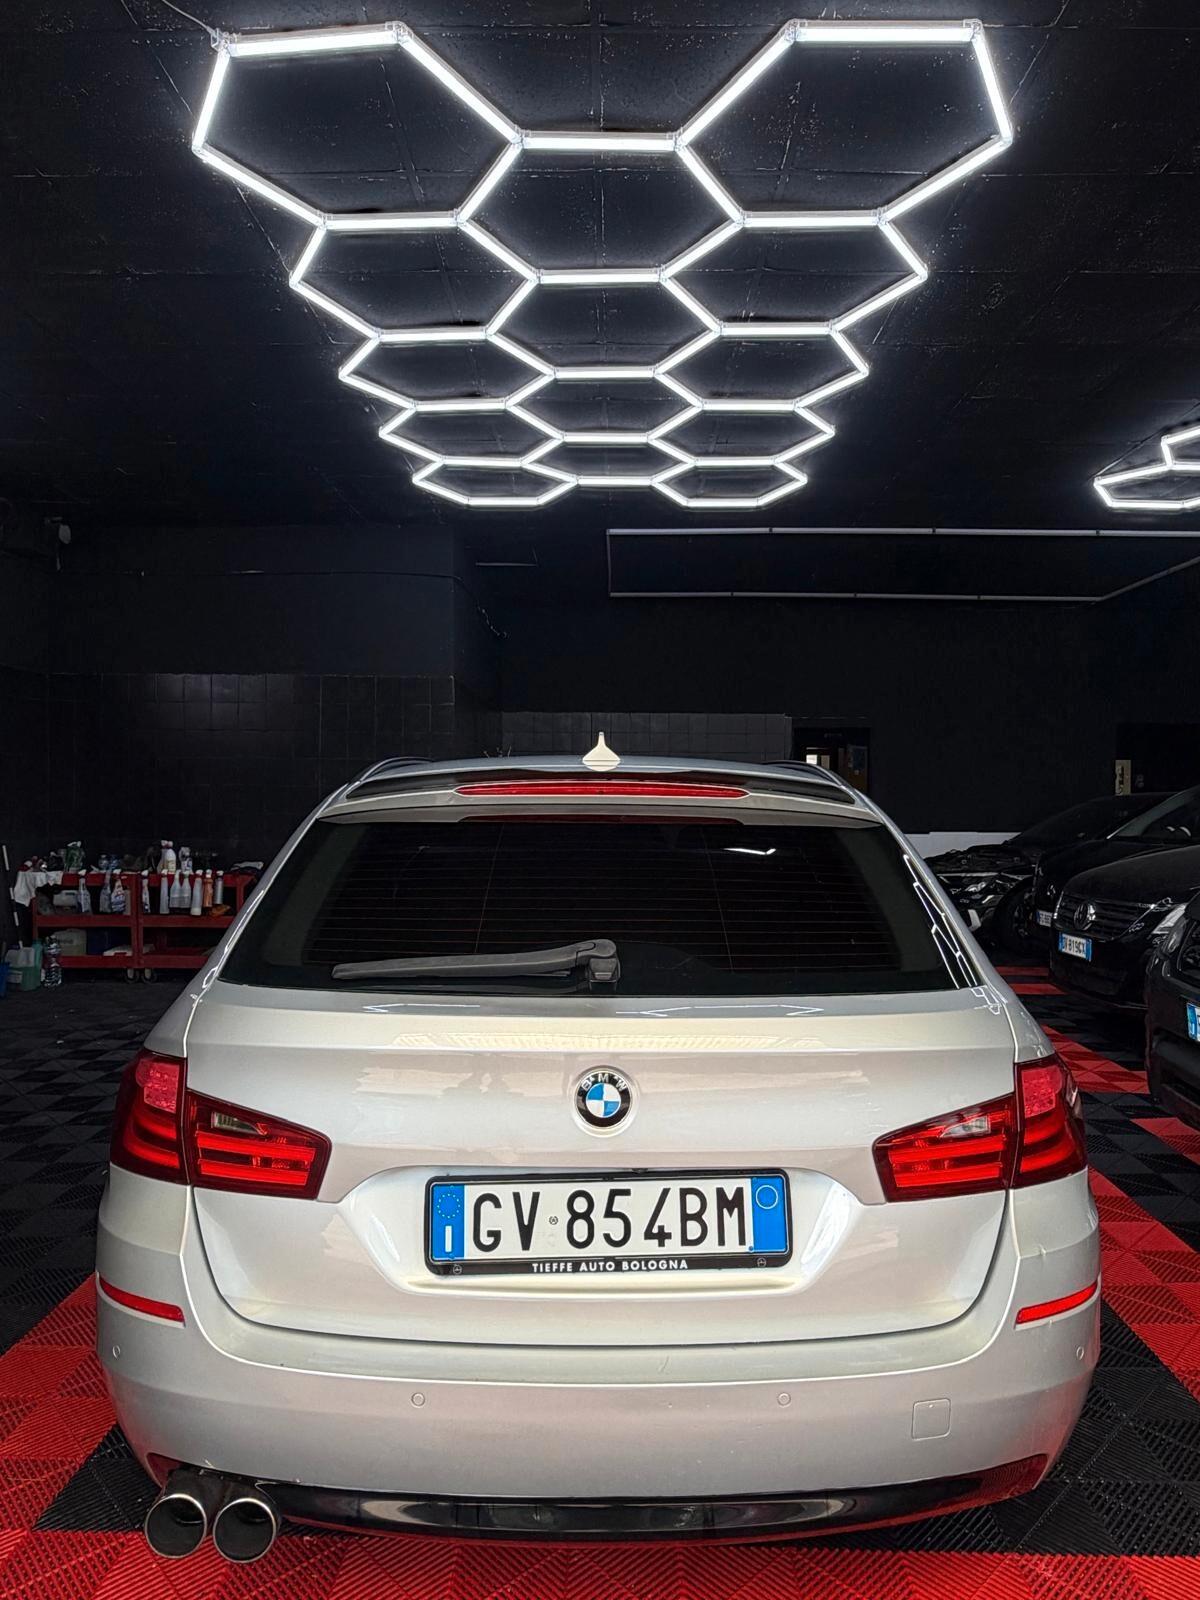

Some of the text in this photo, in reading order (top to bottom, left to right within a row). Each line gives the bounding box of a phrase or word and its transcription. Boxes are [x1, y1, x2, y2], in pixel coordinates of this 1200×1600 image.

[581, 1073, 627, 1092] BMW
[473, 1187, 747, 1253] GV 854BM
[532, 1259, 688, 1273] TIEFFE AUTO BOLOGNA
